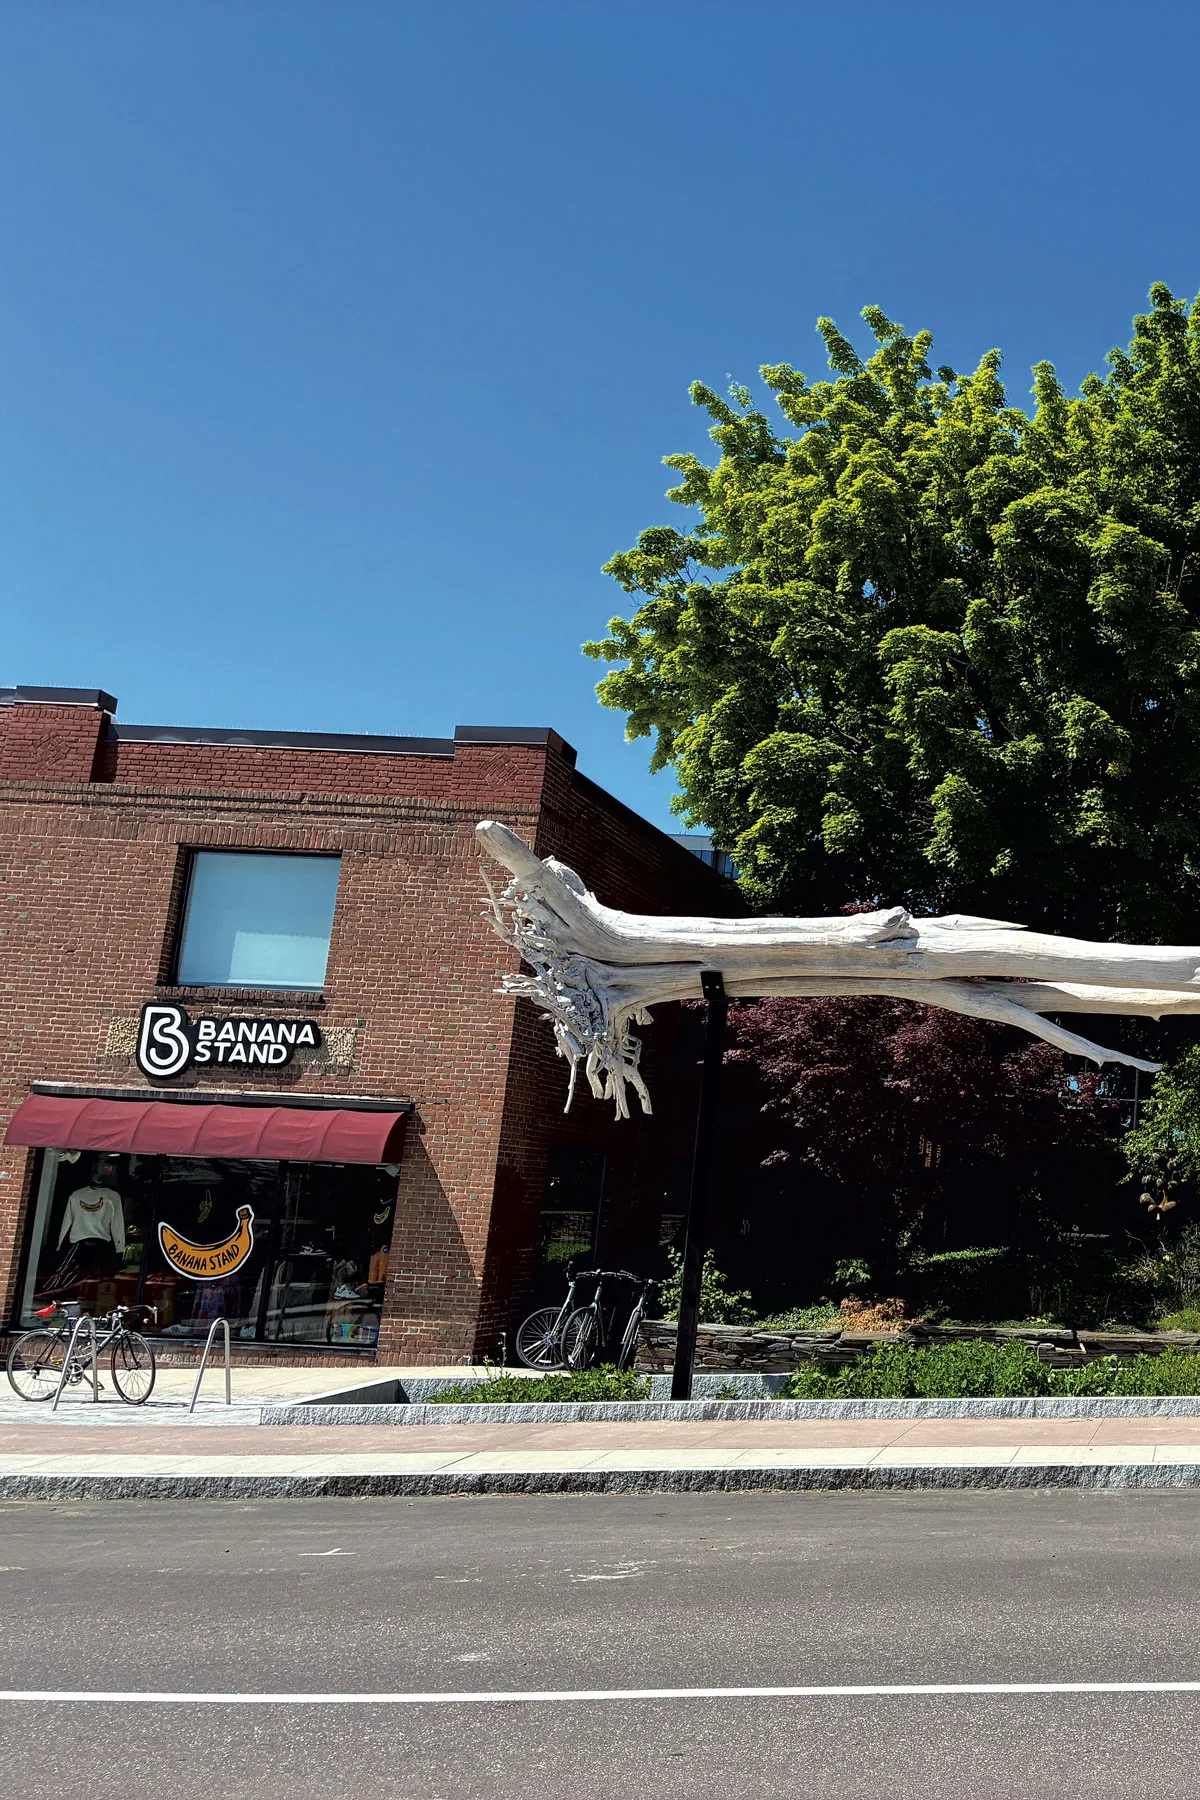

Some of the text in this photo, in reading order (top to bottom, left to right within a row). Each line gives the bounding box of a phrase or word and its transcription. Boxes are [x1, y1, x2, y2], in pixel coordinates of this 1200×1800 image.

[198, 1020, 315, 1045] BANANA
[194, 1041, 288, 1064] STAND
[168, 1243, 240, 1271] BANANA STAND
